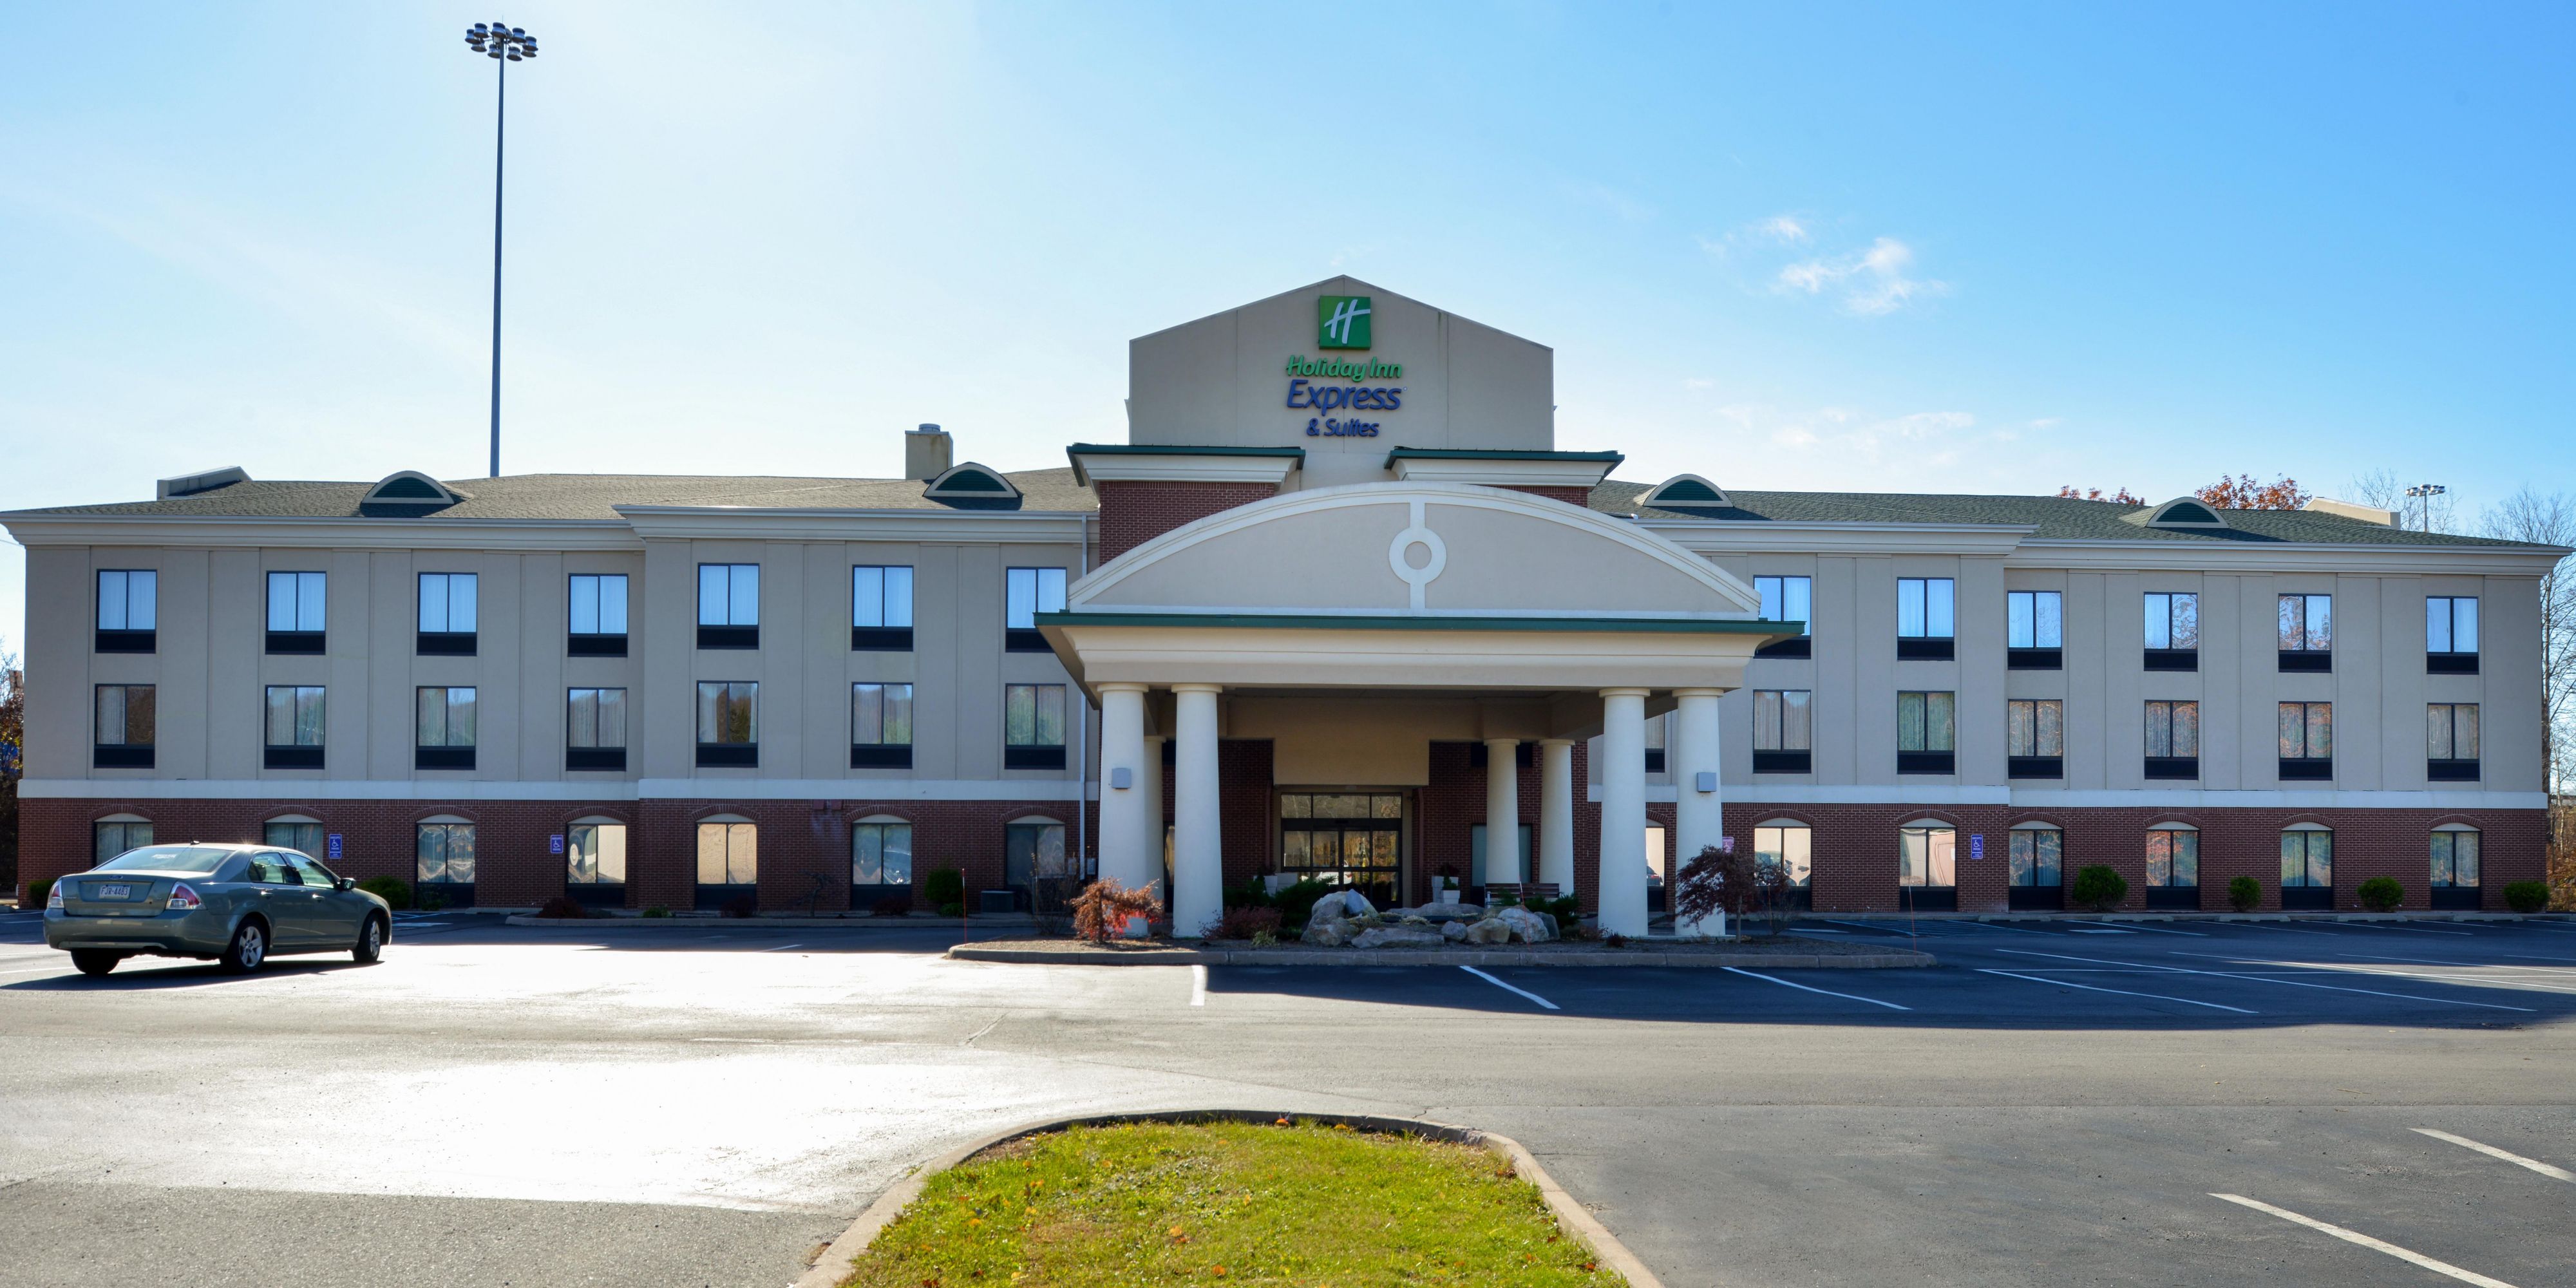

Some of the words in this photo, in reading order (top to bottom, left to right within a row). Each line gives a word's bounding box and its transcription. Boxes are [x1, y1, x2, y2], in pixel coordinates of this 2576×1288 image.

[1324, 299, 1370, 344] H
[1287, 355, 1367, 382] Holiday
[1369, 356, 1402, 378] Inn
[1287, 379, 1402, 417] Express
[1306, 418, 1320, 437] &
[1323, 418, 1380, 437] Suites
